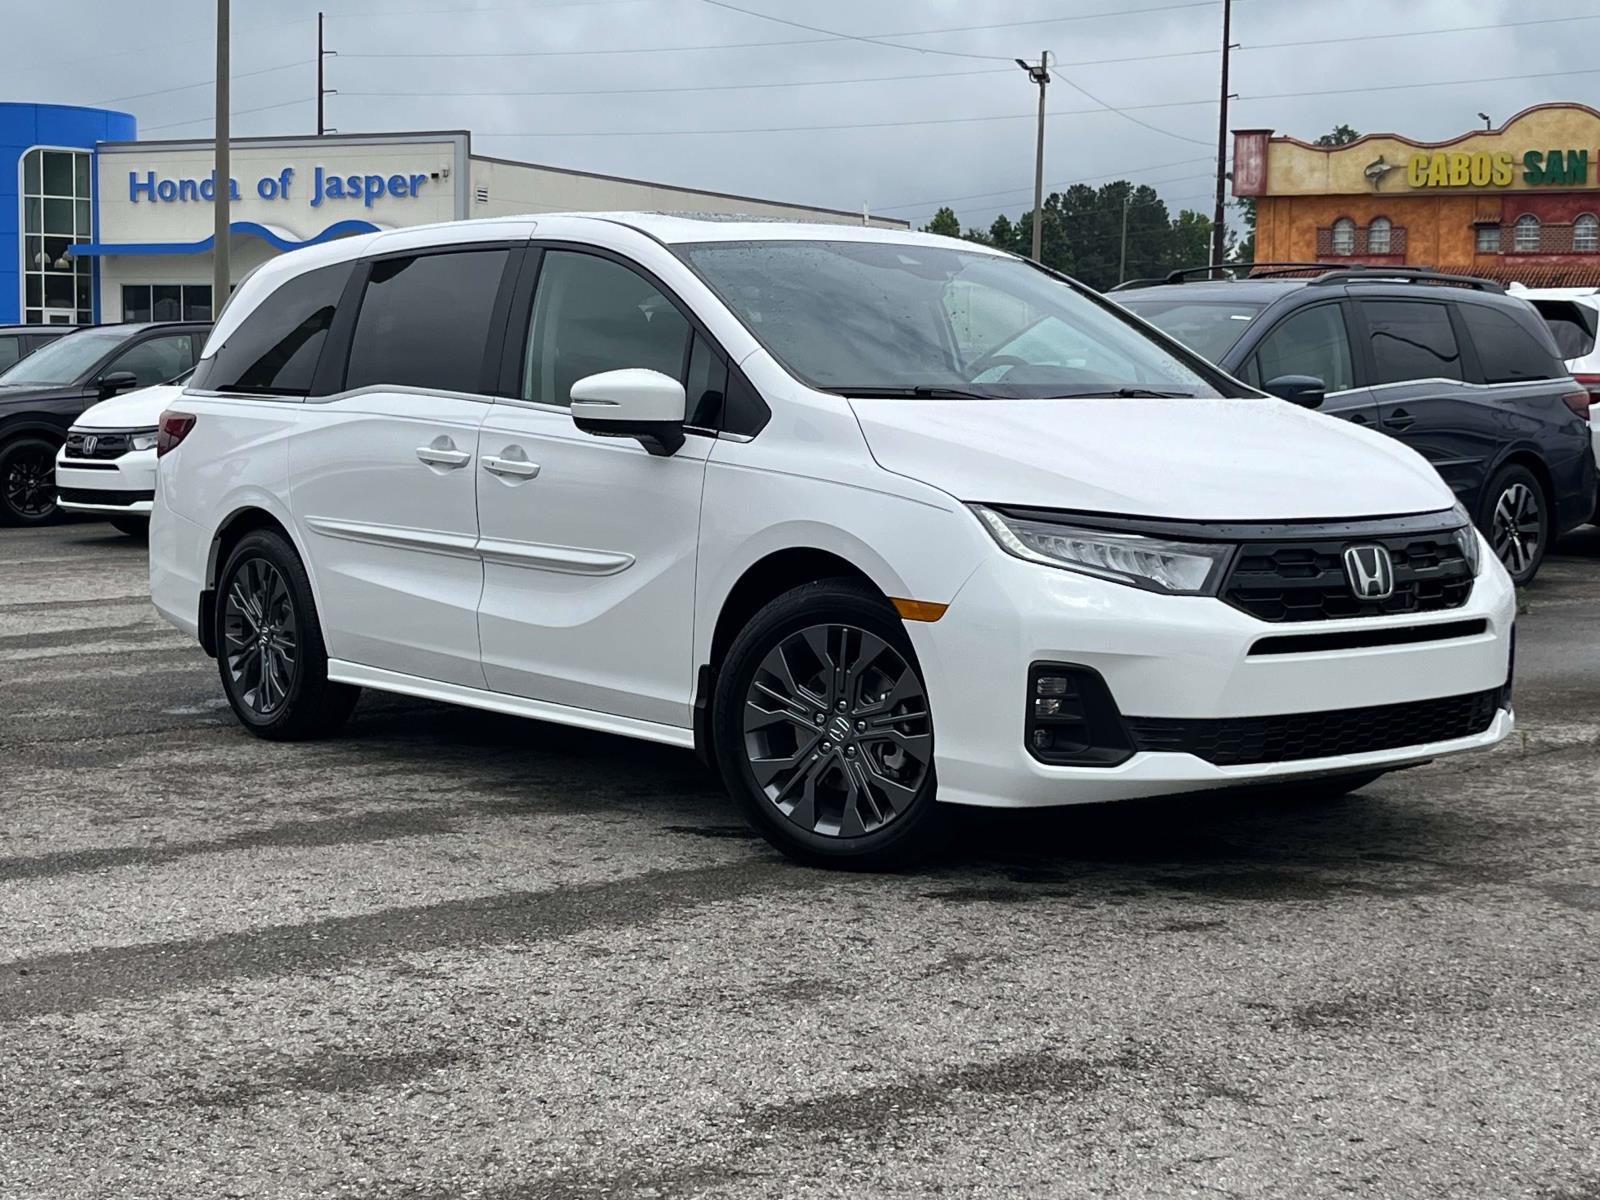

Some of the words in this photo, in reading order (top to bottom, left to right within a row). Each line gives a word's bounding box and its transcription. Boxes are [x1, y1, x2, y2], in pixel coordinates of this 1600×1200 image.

[129, 169, 241, 203] Honda
[257, 167, 294, 200] of
[310, 166, 427, 208] Jasper
[1407, 151, 1513, 188] CABOS
[1522, 149, 1588, 186] SAN
